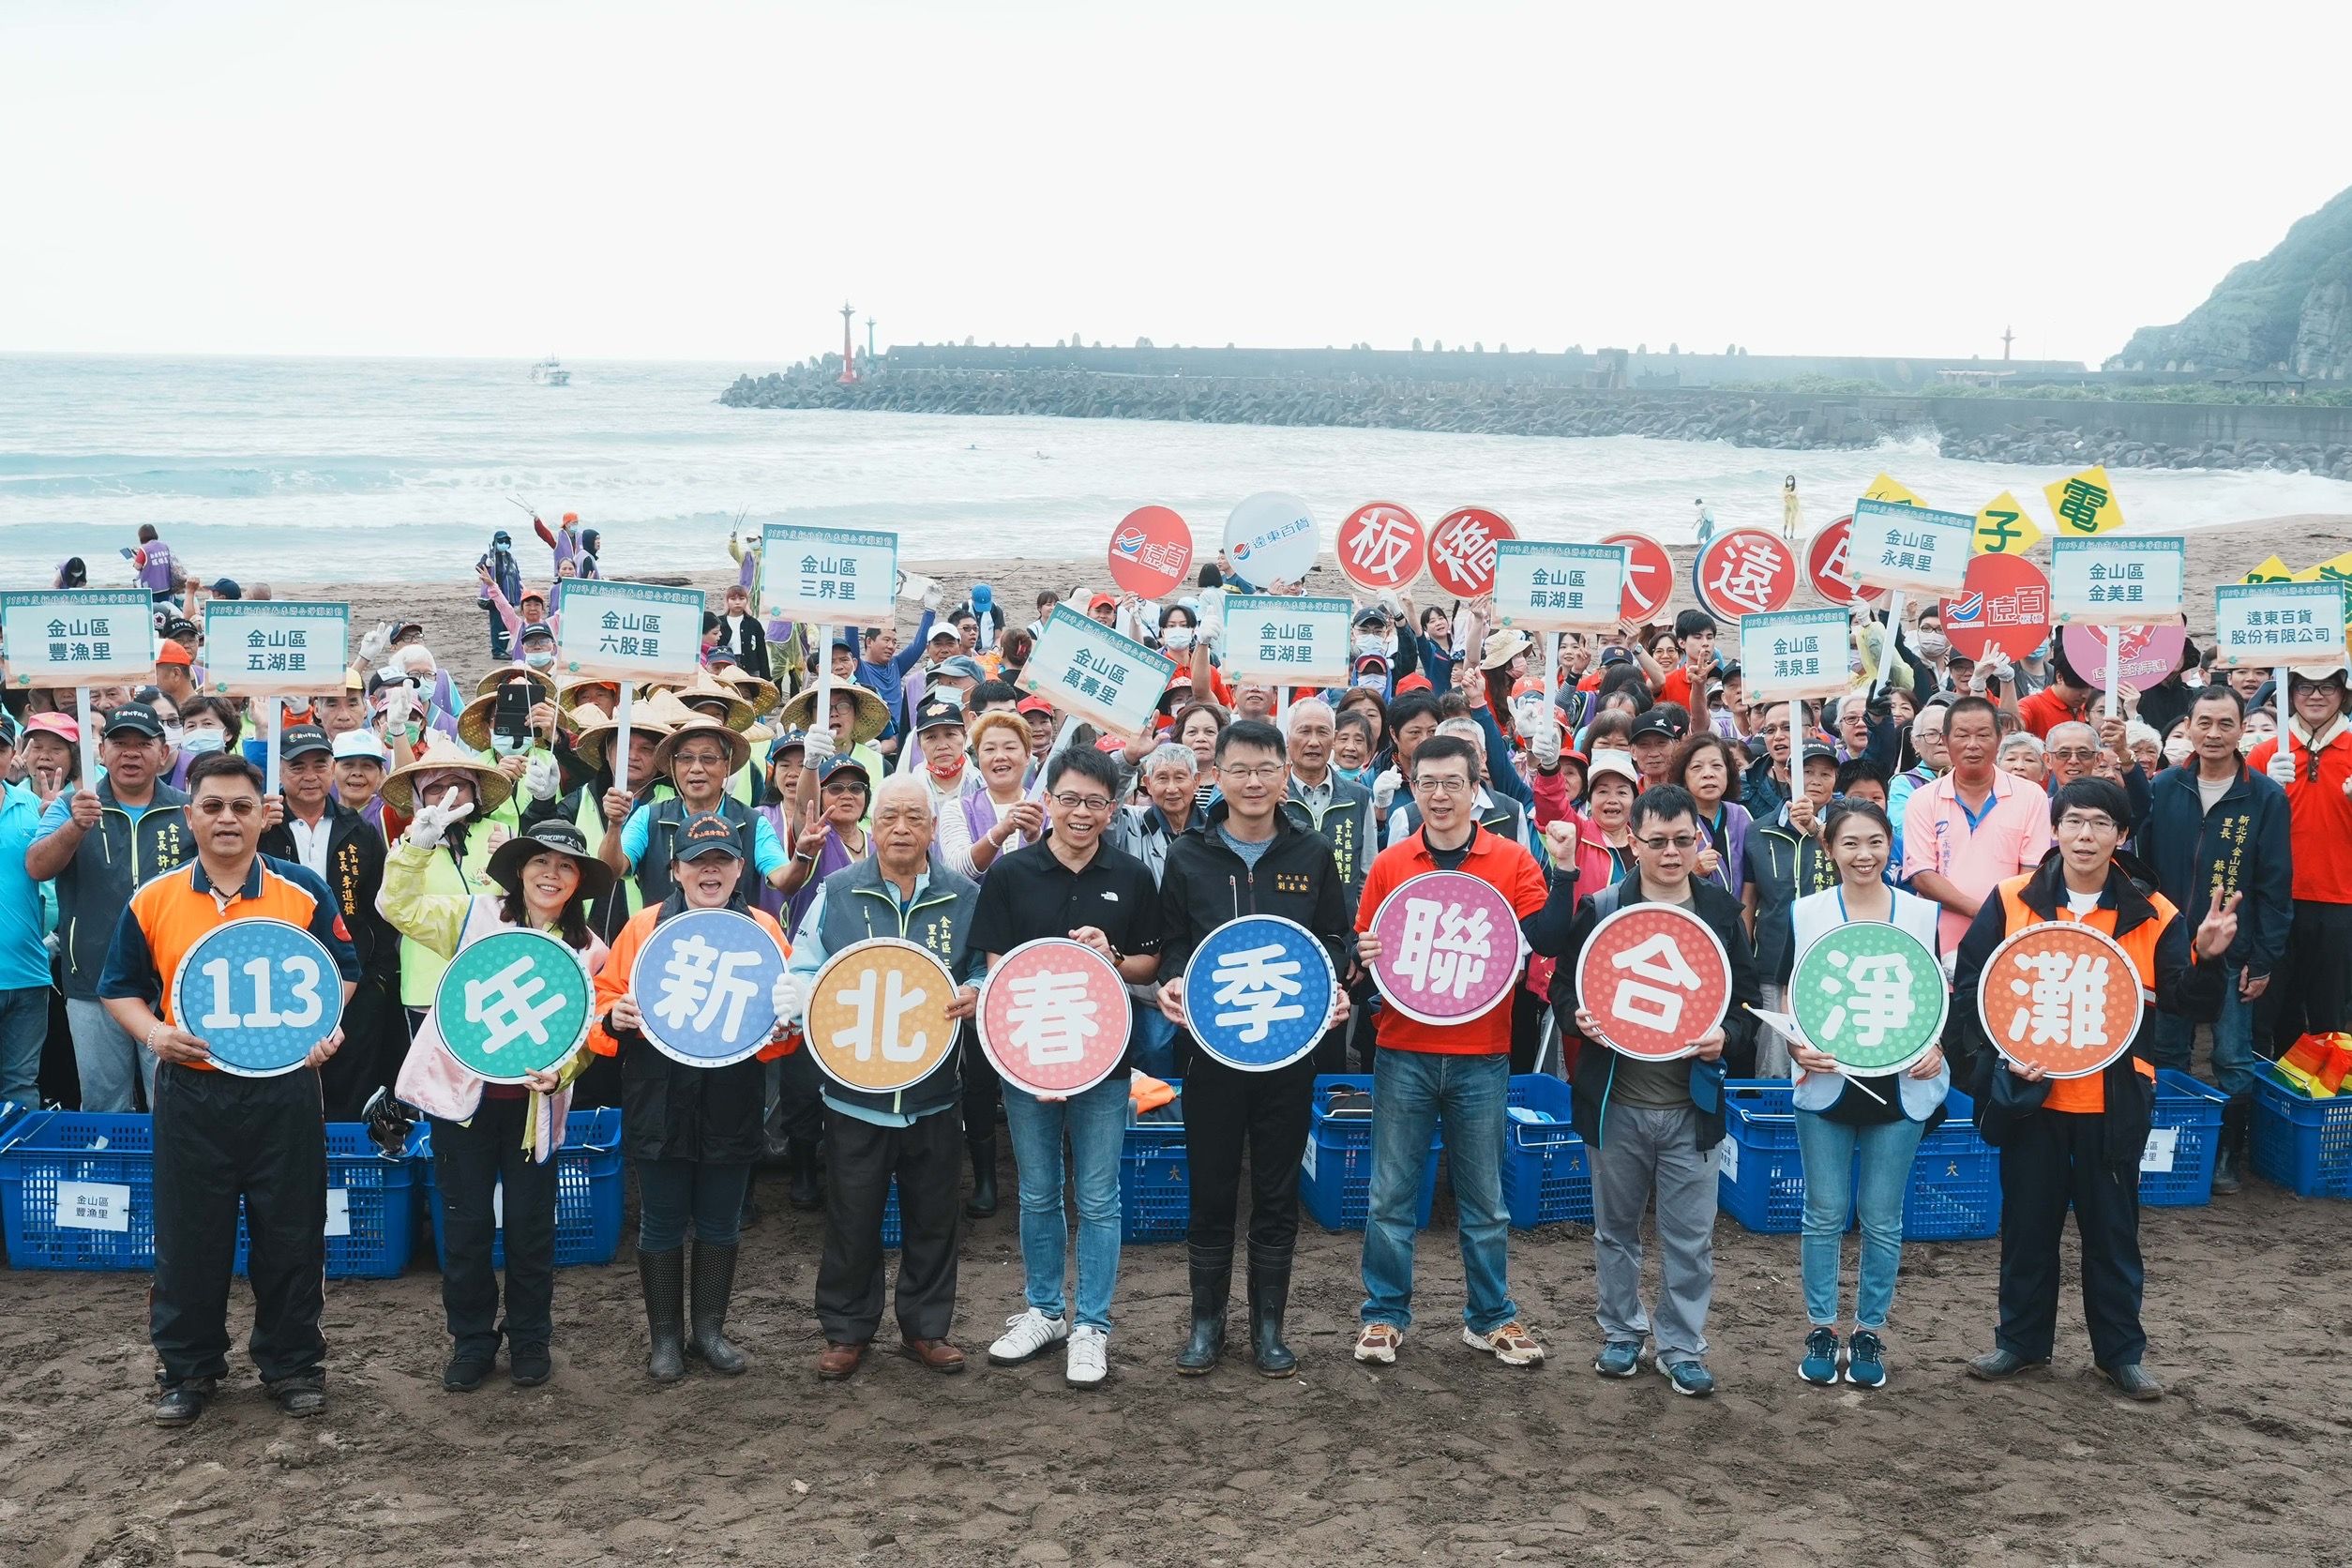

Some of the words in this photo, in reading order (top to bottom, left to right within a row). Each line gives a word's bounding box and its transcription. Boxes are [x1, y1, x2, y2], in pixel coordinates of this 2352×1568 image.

[2058, 477, 2108, 533] 電
[1250, 517, 1310, 550] 遠東百貨
[1885, 528, 1937, 551] 金山區
[1978, 509, 2022, 552] 子
[1348, 509, 1415, 583] 板
[1433, 515, 1498, 591] 橋
[801, 554, 857, 577] 金山區
[1880, 549, 1933, 572] 永興里
[2088, 563, 2145, 580] 金山區
[1531, 567, 1587, 587] 金山區
[1710, 535, 1782, 612] 遠
[799, 580, 856, 600] 三界里
[1530, 590, 1584, 609] 兩湖里
[2088, 584, 2144, 602] 金美里
[1986, 585, 2045, 627] 遠百
[2247, 609, 2313, 626] 遠東百貨
[47, 618, 111, 638] 金山區
[601, 610, 661, 634] 金山區
[1260, 622, 1314, 641] 金山區
[247, 629, 308, 648] 金山區
[599, 634, 658, 657] 六股里
[1773, 636, 1819, 656] 金山區
[2231, 627, 2330, 645] 股份有限公司
[49, 641, 112, 661] 豐漁里
[247, 654, 307, 671] 五湖里
[1259, 644, 1313, 663] 西湖里
[1072, 647, 1129, 686] 金山區
[1774, 657, 1819, 677] 清泉里
[1062, 666, 1118, 706] 萬壽里
[2220, 817, 2233, 839] 里長
[1344, 817, 1354, 883] 金山區西湖里
[1393, 897, 1498, 1000] 聯
[201, 955, 324, 1029] 113
[654, 934, 762, 1043] 新
[1212, 943, 1304, 1043] 季
[1611, 933, 1702, 1033] 合
[464, 955, 566, 1055] 年
[1819, 948, 1915, 1048] 淨
[2008, 950, 2109, 1048] 灘
[831, 969, 927, 1063] 北
[1005, 969, 1100, 1066] 春
[76, 1195, 110, 1207] 金山區
[75, 1207, 109, 1219] 豐漁里
